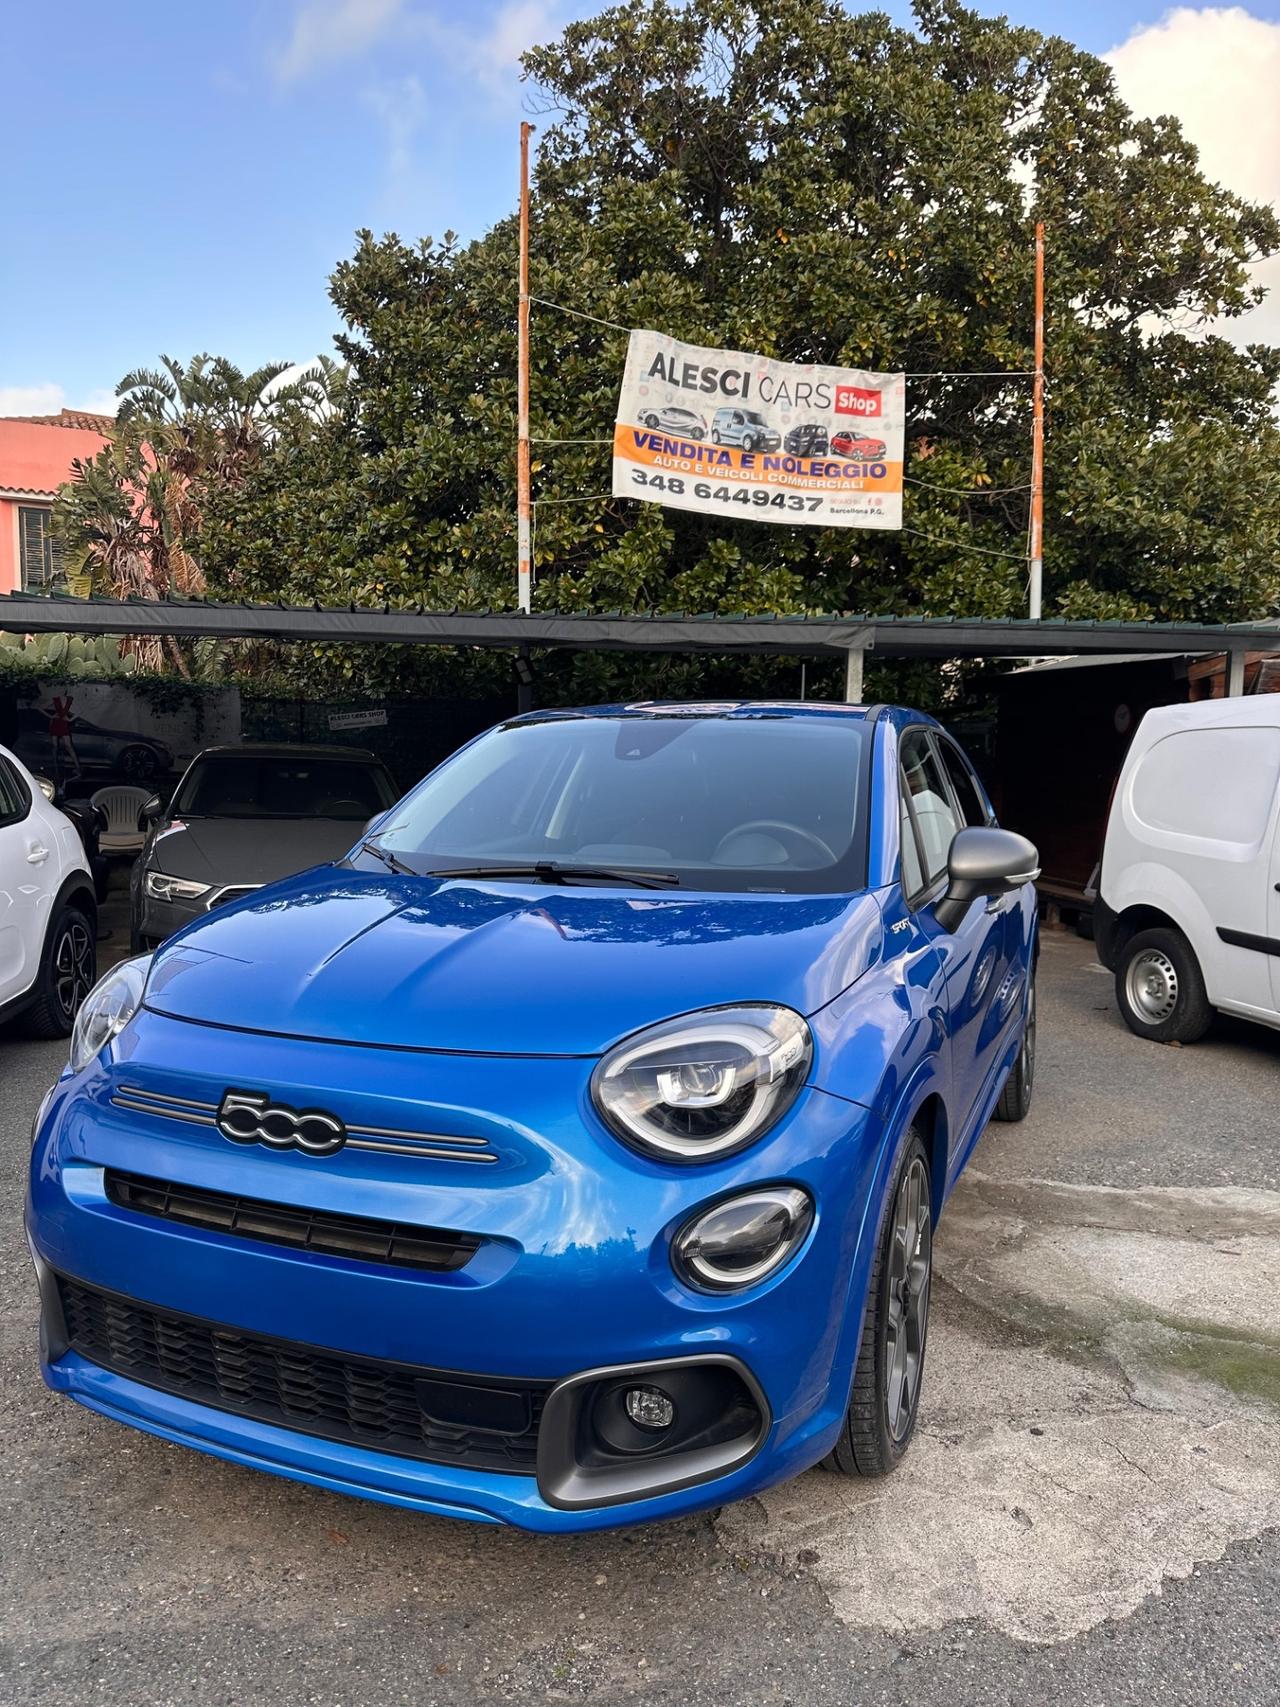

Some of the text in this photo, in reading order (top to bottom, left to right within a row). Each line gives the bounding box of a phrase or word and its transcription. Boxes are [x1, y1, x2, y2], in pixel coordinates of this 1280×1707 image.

[647, 351, 877, 416] ALESCI CARS Shop
[633, 431, 887, 479] VENDITA E NOLEGGIO
[653, 455, 864, 489] AUTO E VEICOLI COMMERCIALI
[631, 468, 824, 512] 348 6449437
[368, 710, 385, 718] SHOP
[220, 1093, 342, 1150] 500
